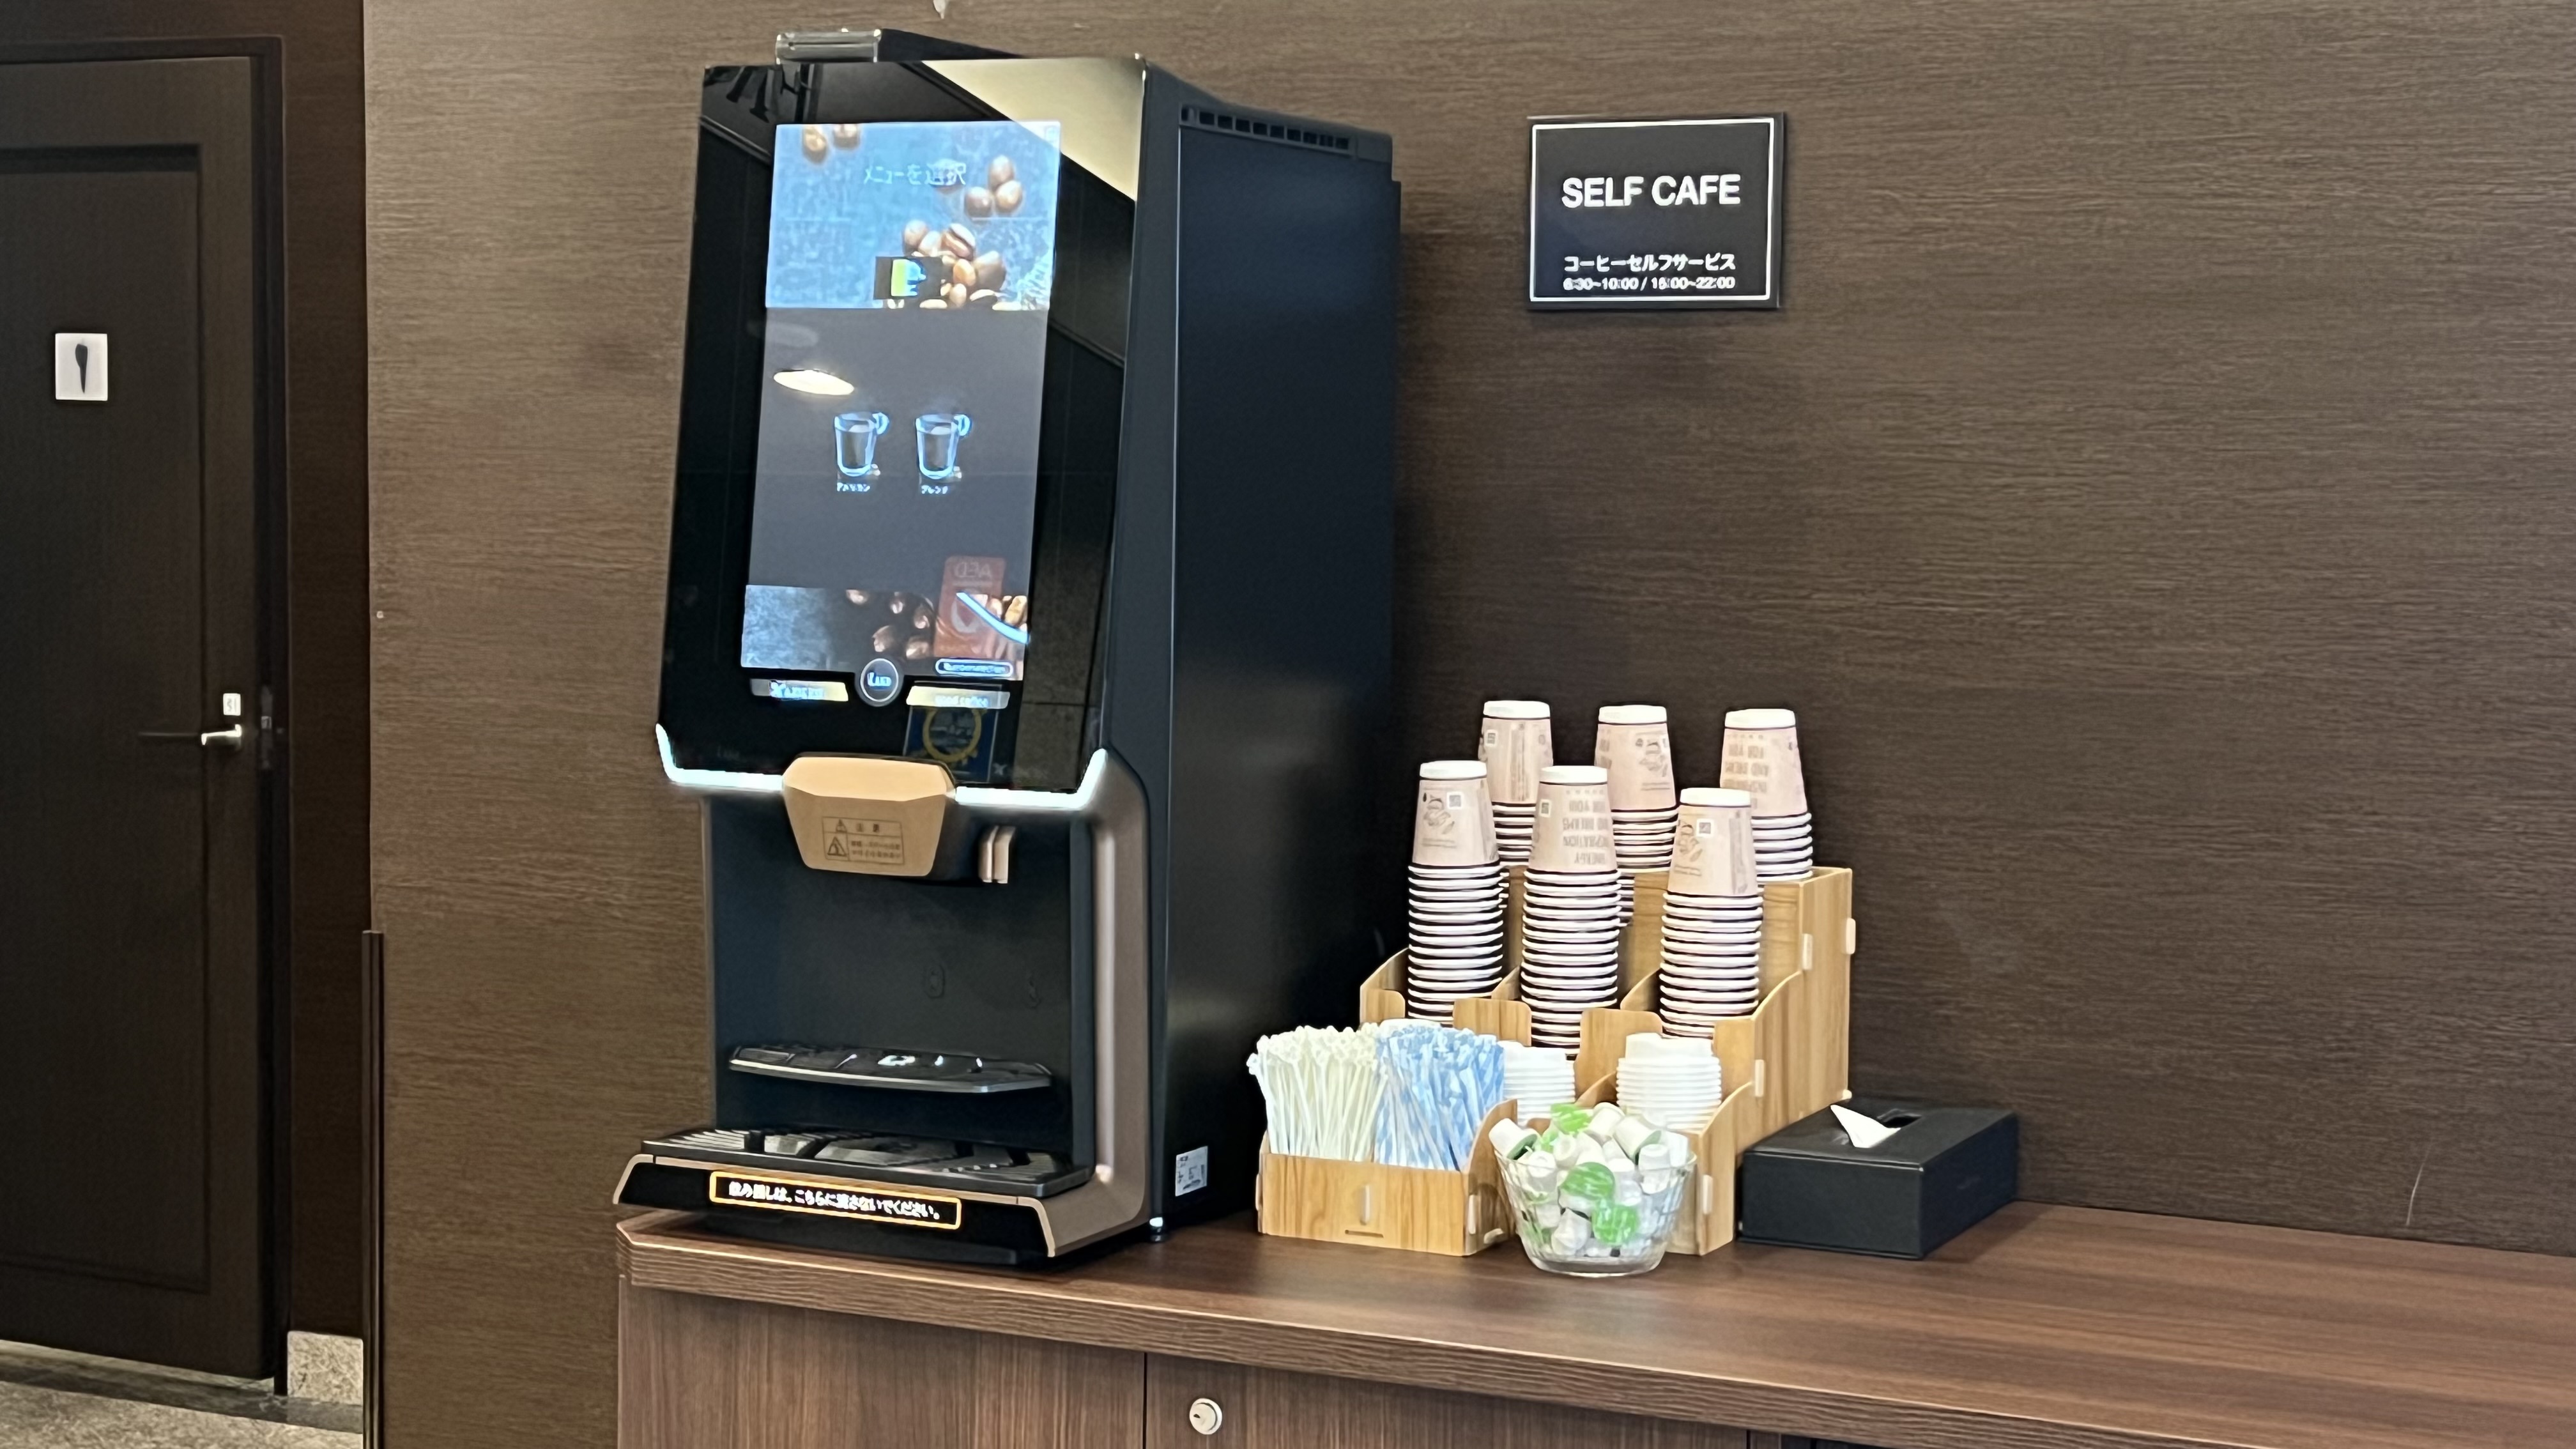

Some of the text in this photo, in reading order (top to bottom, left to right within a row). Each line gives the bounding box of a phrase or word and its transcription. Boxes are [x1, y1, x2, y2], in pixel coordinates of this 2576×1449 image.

[863, 162, 967, 186] メニューを選択
[1561, 174, 1741, 208] SELF CAFE
[1564, 252, 1736, 272] コーヒーセルフサービス
